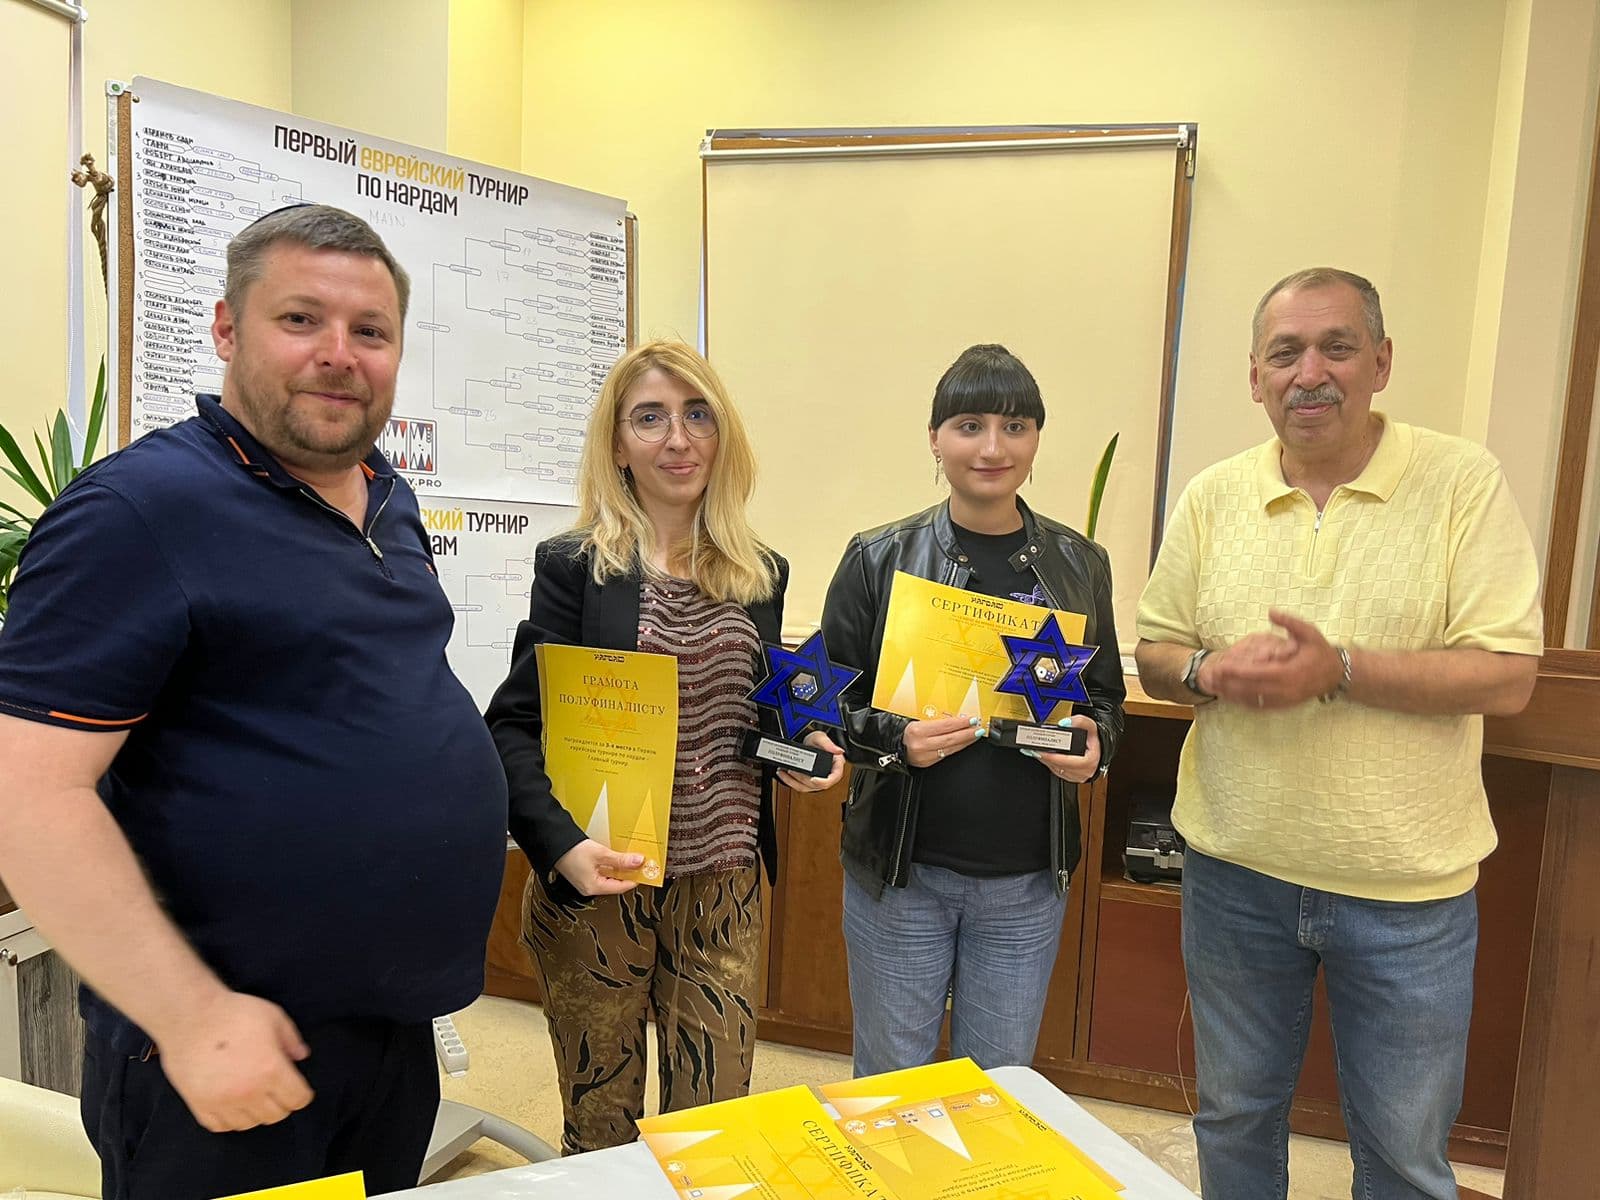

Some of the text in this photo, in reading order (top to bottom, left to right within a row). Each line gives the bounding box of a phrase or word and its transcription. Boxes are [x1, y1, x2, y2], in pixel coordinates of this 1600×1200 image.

[357, 173, 381, 198] ПО
[467, 173, 529, 206] ТУРНИР
[466, 511, 529, 535] ТУРНИР
[931, 596, 1040, 632] СЕРТИФИКАТ
[583, 675, 640, 691] ГРАМОТА
[560, 693, 666, 716] ПОЛУФИНАЛИСТУ
